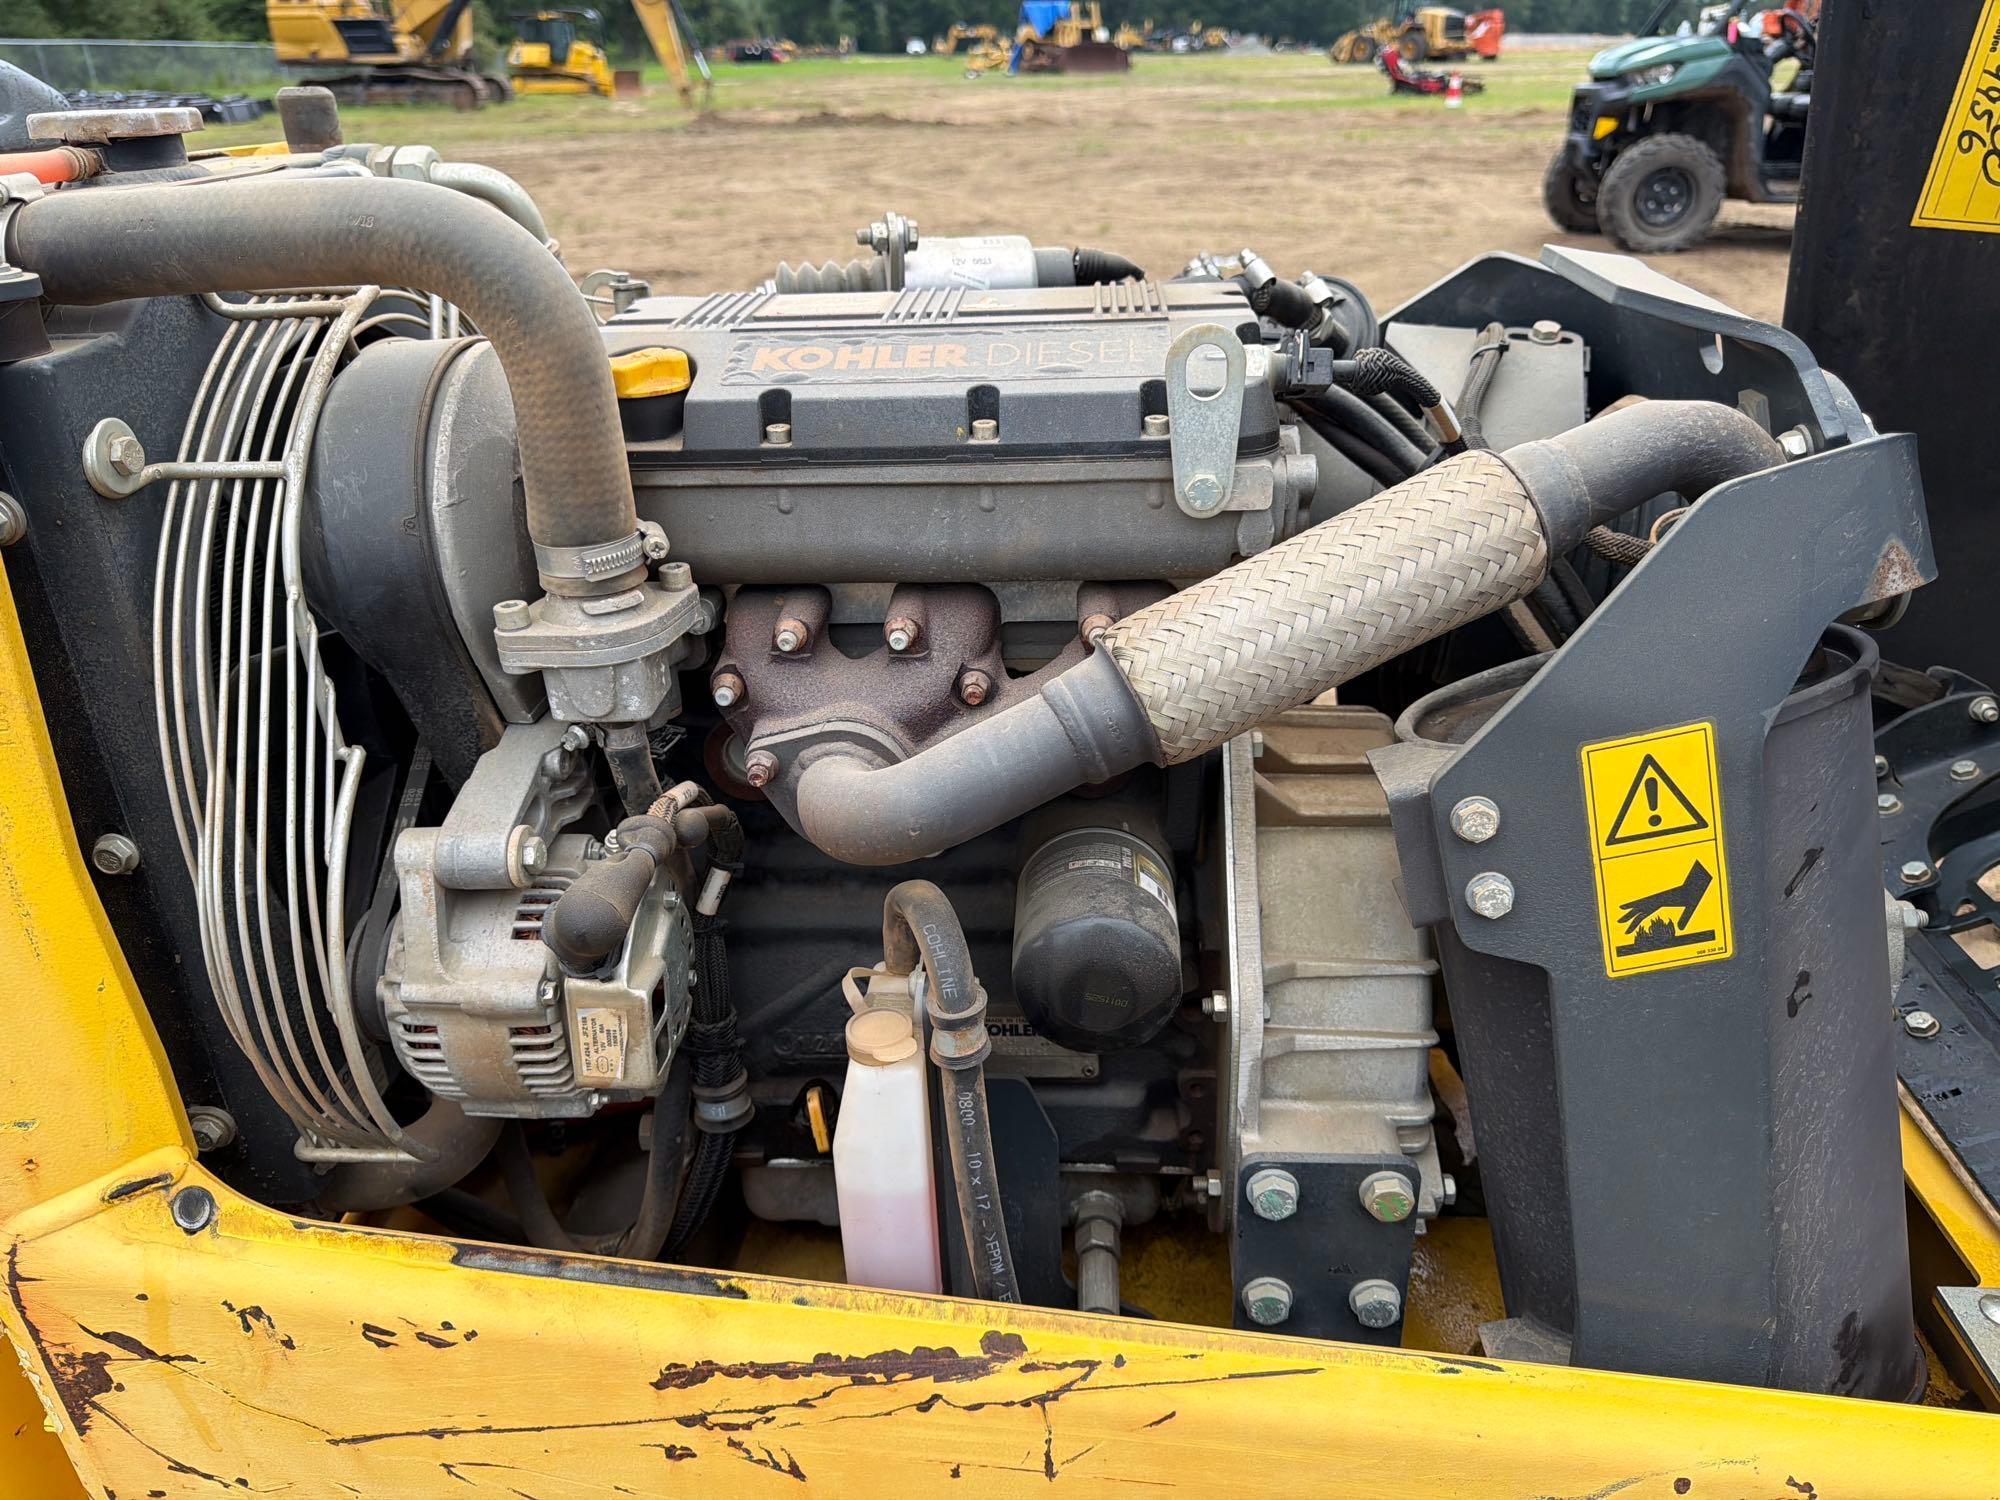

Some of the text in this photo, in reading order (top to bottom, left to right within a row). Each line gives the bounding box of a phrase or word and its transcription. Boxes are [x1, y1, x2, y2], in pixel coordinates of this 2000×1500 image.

[750, 338, 1147, 372] KOHLER DIESEL
[922, 923, 958, 1000] COHLINE
[591, 1017, 599, 1054] ALTERNATOR
[985, 1024, 1038, 1037] OHLE
[967, 1151, 983, 1169] 10
[975, 1193, 991, 1210] 17
